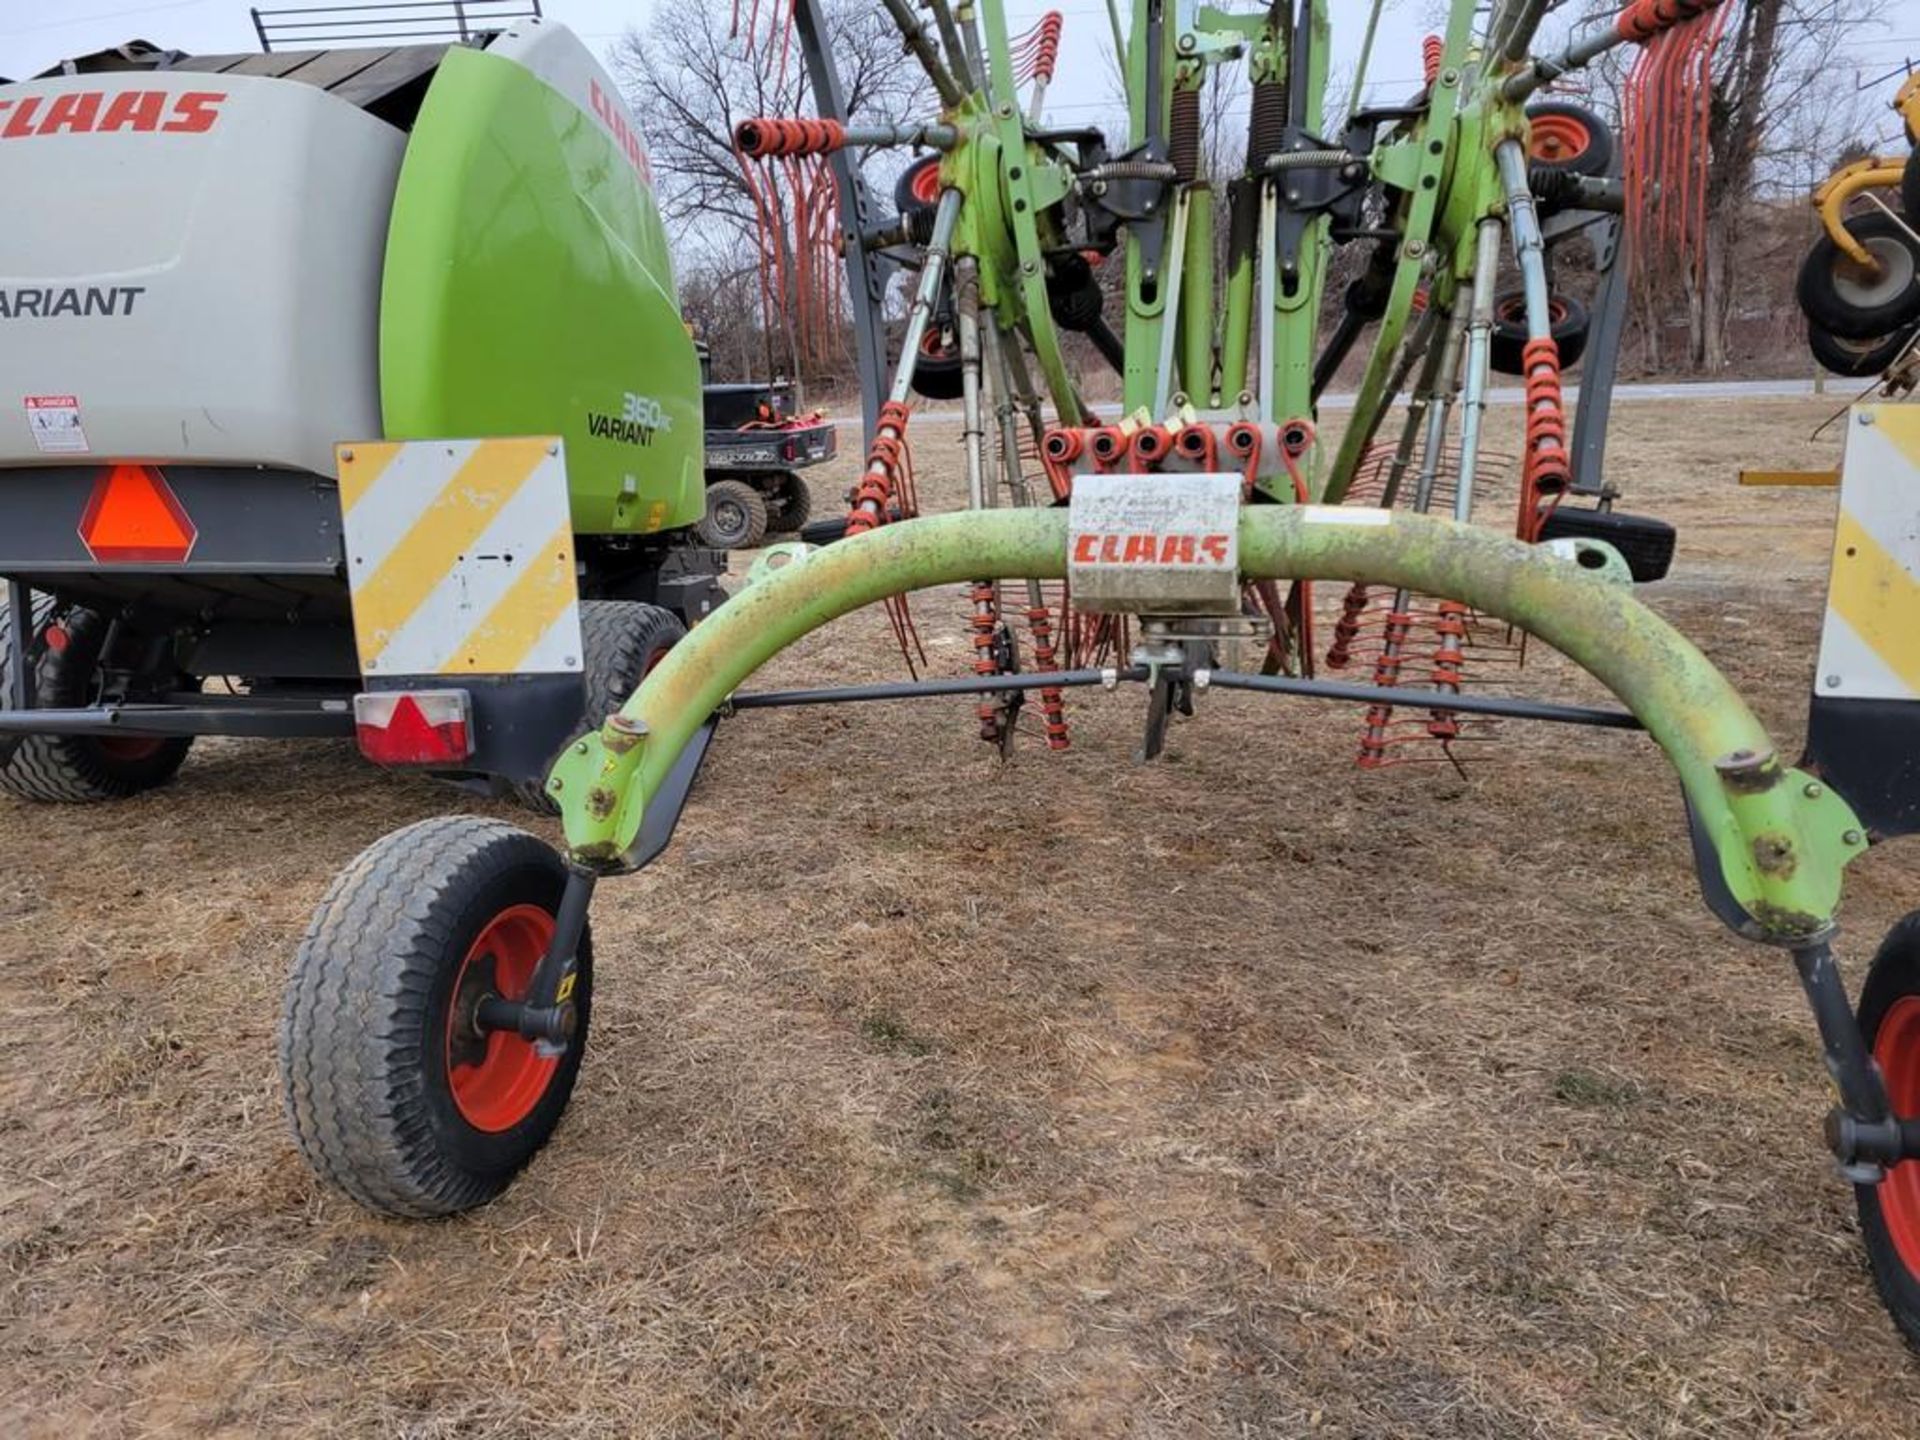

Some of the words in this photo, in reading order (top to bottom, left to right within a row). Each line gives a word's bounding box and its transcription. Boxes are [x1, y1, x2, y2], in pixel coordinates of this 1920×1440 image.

[0, 91, 228, 138] LAAS
[588, 412, 655, 447] VARIANT
[1074, 535, 1230, 564] CLAAS
